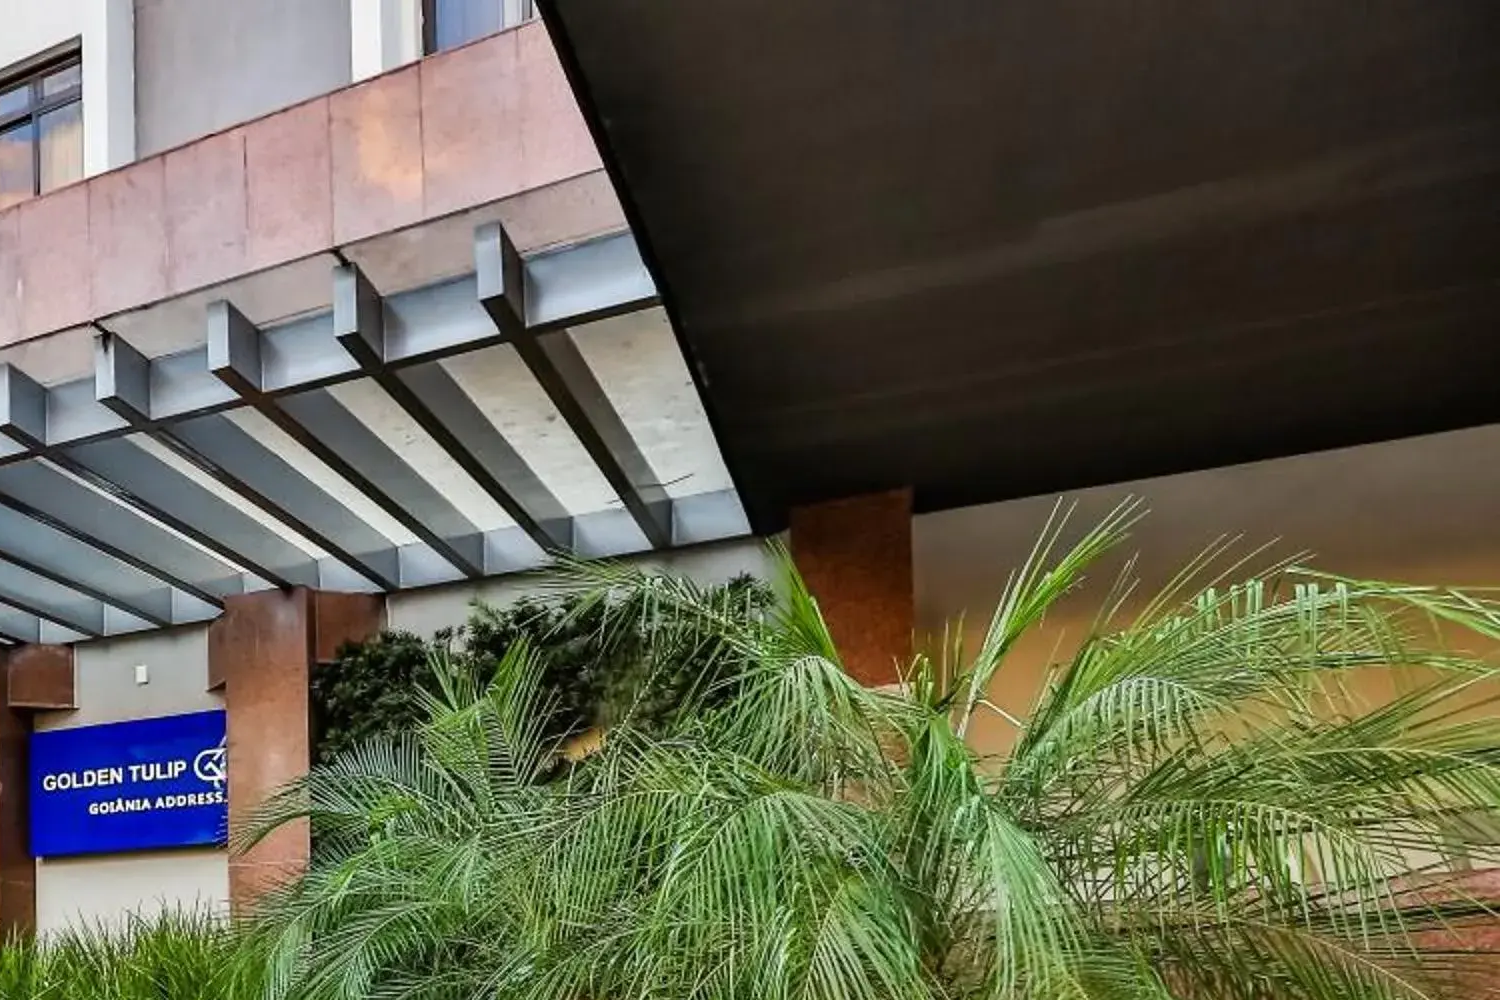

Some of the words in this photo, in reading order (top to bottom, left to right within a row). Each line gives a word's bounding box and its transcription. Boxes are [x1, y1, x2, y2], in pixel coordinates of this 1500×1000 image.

[43, 767, 123, 791] GOLDEN
[128, 760, 187, 783] TULIP
[88, 798, 151, 815] GOIÂNIA
[155, 792, 224, 809] ADDRESS
